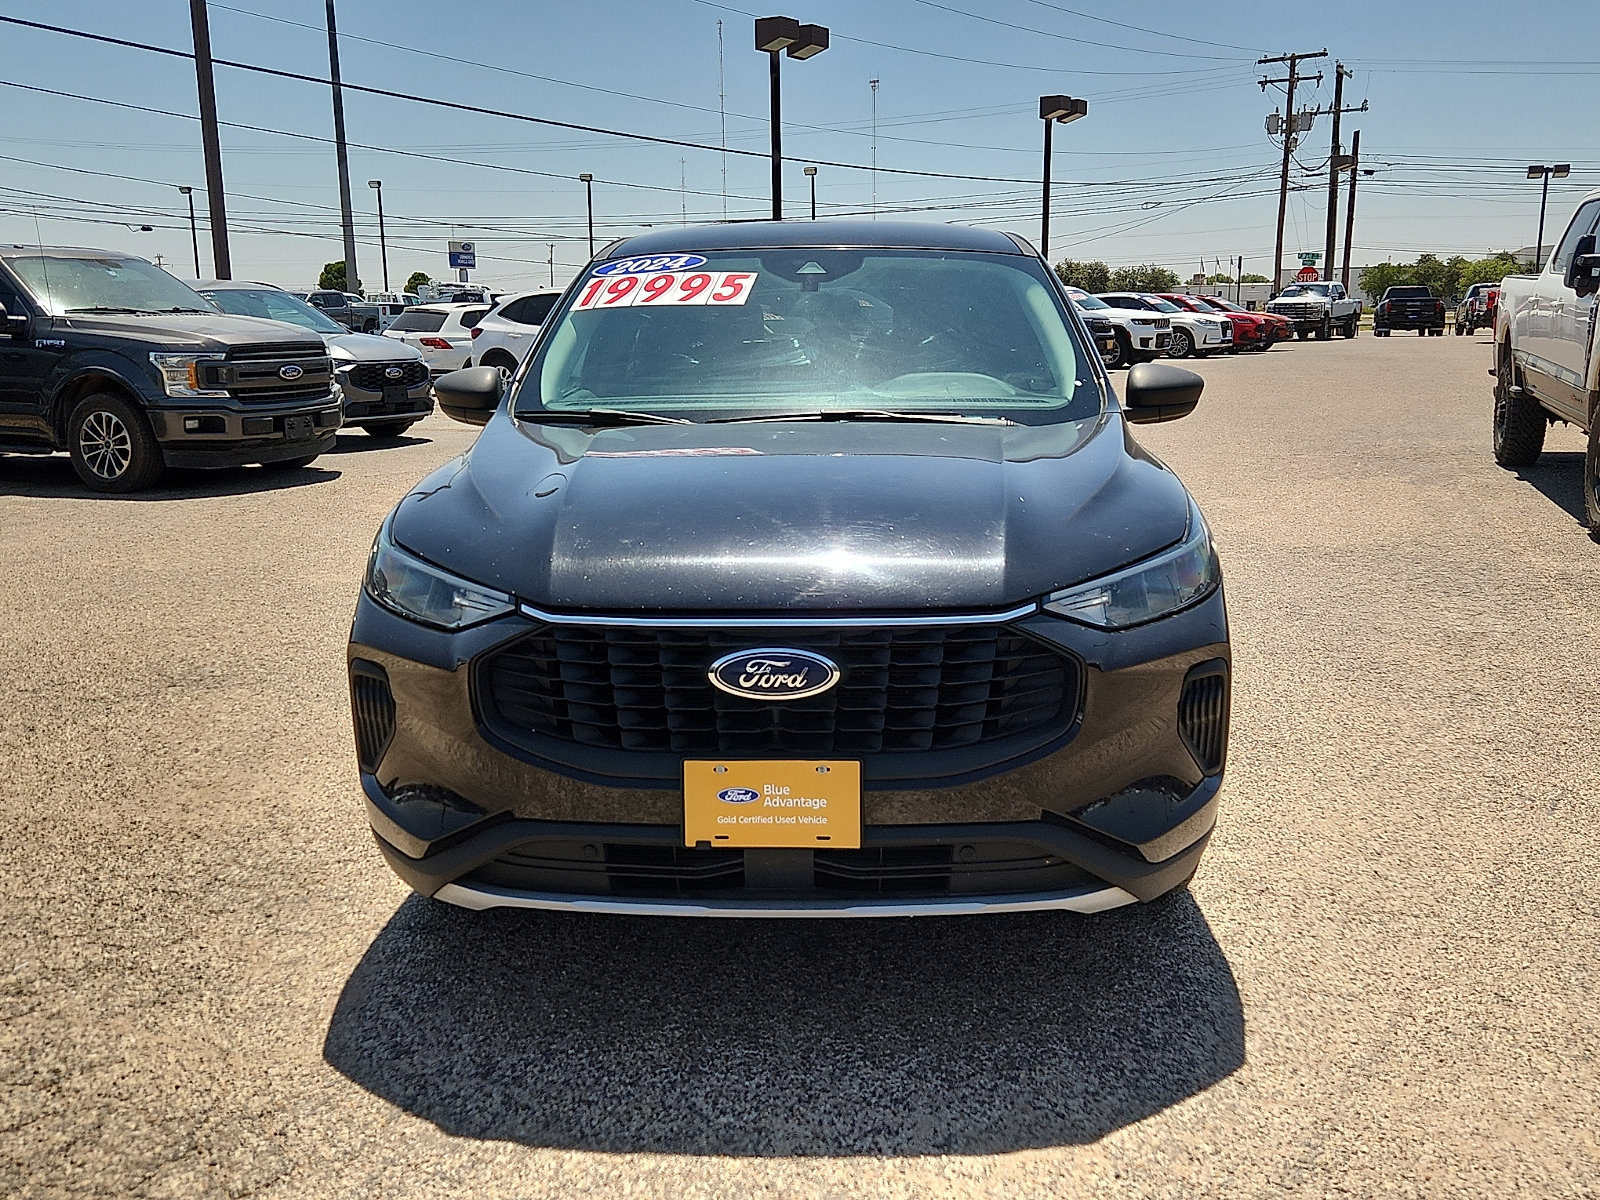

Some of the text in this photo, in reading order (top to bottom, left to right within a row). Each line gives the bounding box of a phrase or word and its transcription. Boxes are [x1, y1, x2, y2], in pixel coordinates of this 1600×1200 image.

[611, 255, 686, 274] 2024
[1298, 273, 1318, 282] STOP
[578, 273, 752, 307] 19995
[738, 659, 809, 688] Ford
[724, 789, 753, 802] Ford
[763, 784, 790, 795] Blue
[763, 796, 827, 809] Advantage
[717, 815, 828, 824] Gold Certified Used Vehicle
